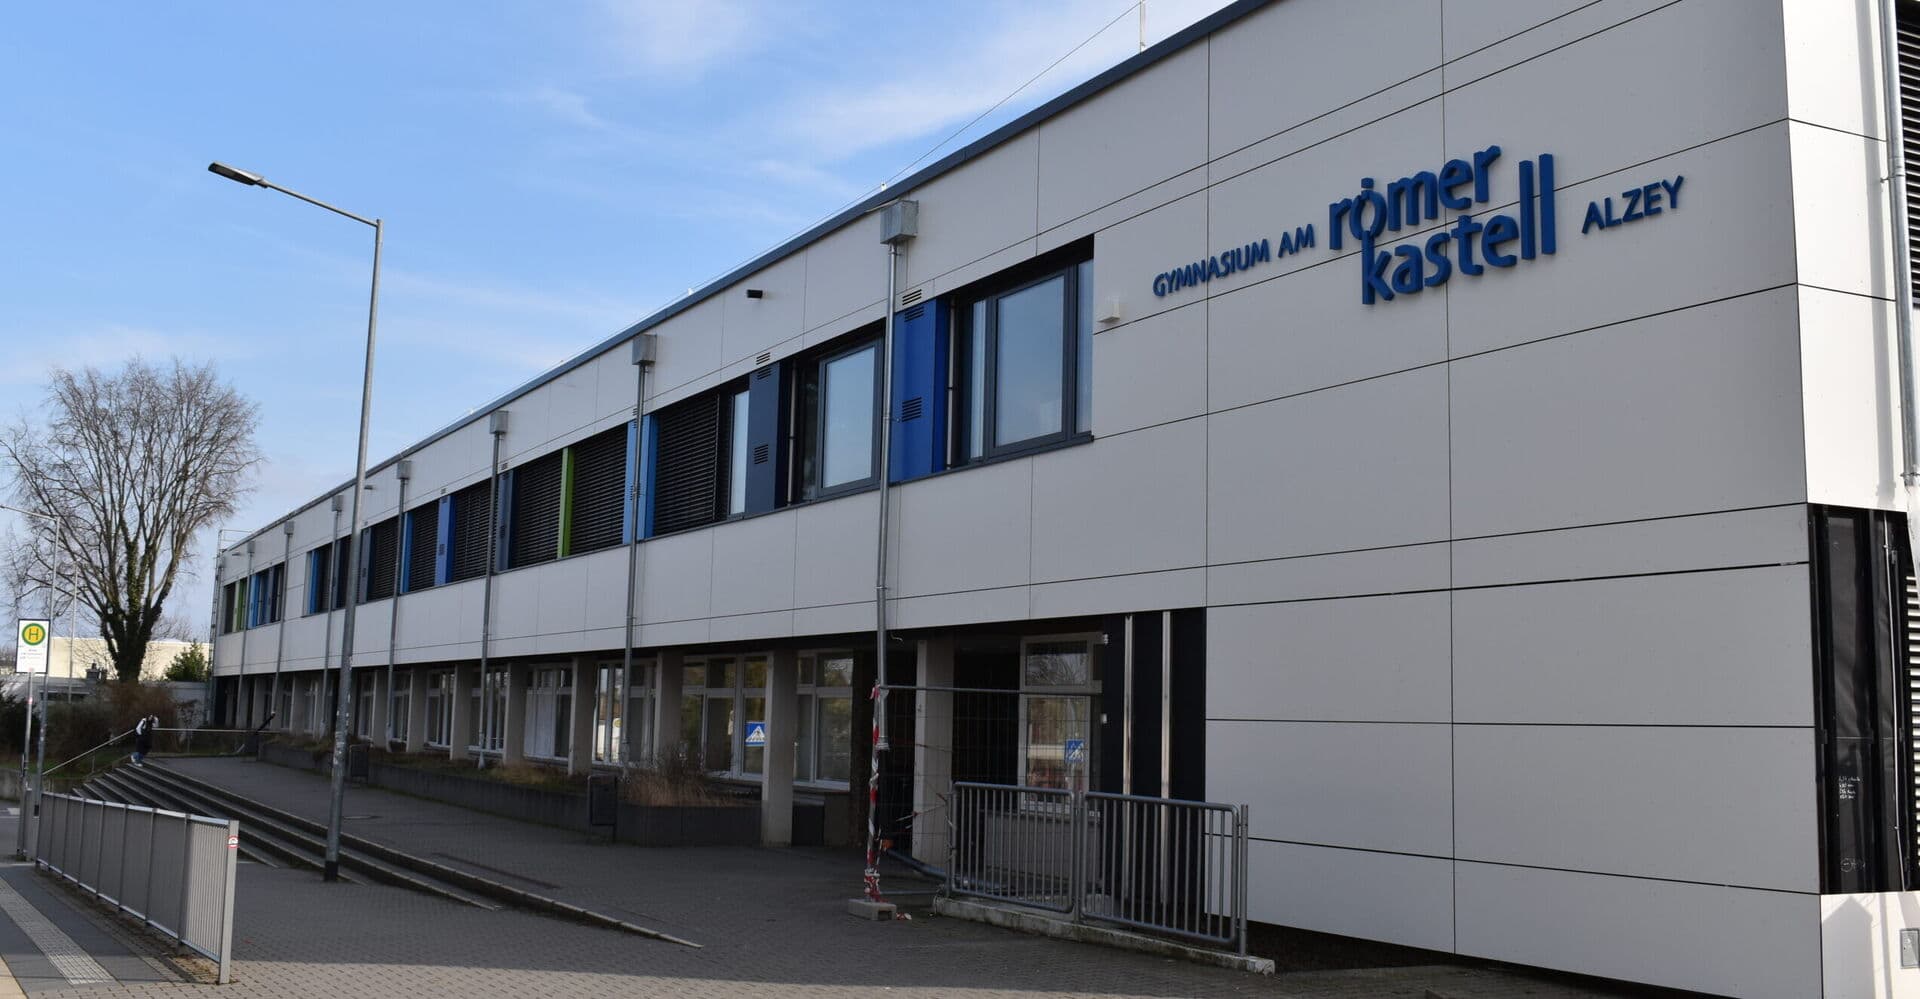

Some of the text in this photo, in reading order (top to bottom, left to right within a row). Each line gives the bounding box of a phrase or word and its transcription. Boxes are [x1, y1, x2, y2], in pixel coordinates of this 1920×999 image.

[1362, 153, 1557, 305] kastell
[1582, 175, 1685, 235] ALZEY
[1152, 223, 1316, 298] GYMNASIUM AM
